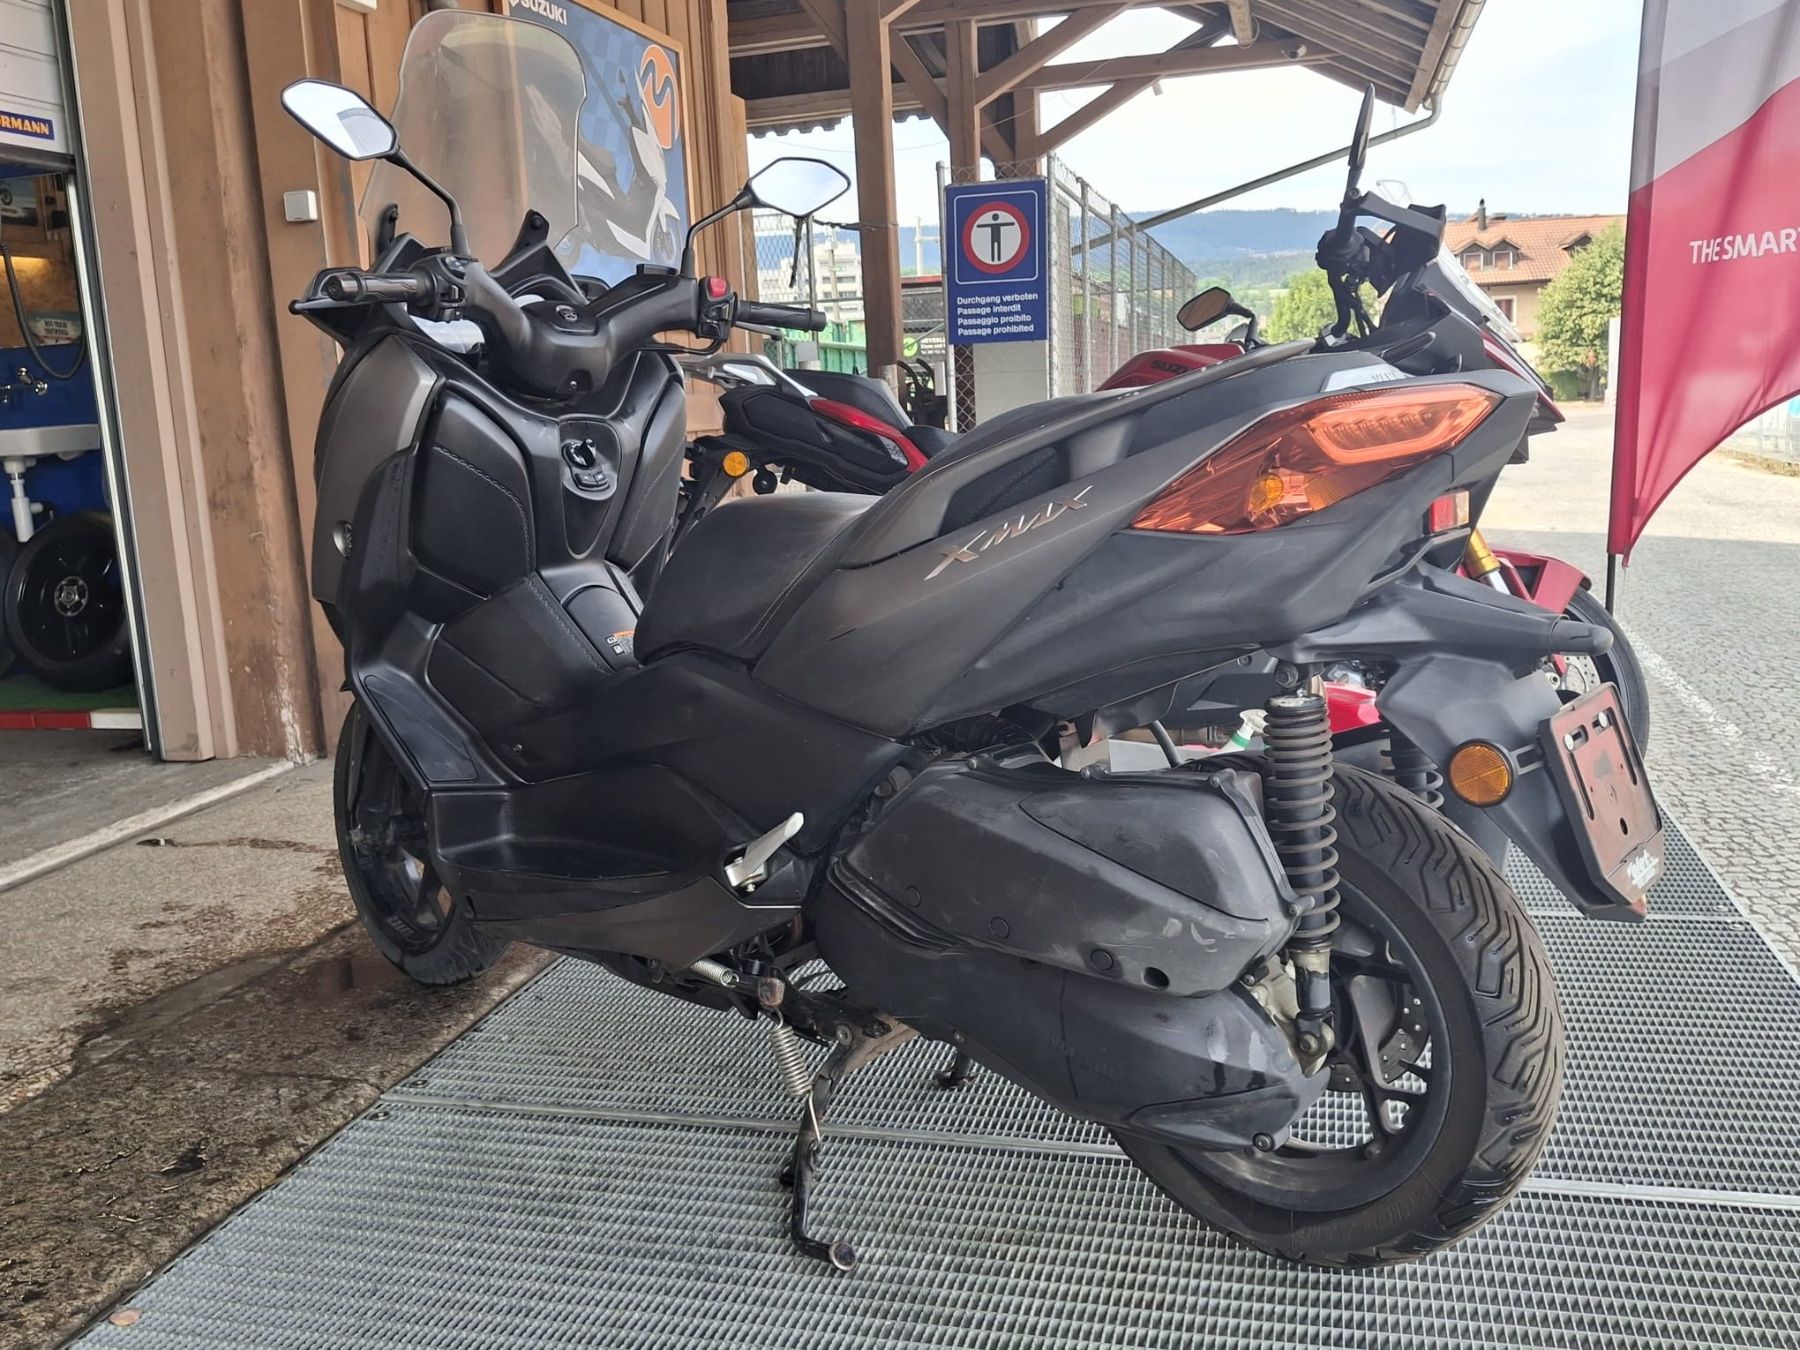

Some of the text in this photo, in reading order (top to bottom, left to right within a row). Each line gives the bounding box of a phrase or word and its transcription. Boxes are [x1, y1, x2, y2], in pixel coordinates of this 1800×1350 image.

[0, 114, 49, 135] RMANN
[1690, 227, 1800, 264] THE SMAR
[957, 292, 1039, 305] Durchgang verboten
[957, 303, 1021, 315] Passage interdit
[957, 314, 1032, 326] Passaggio proibito
[958, 324, 1034, 336] Passage prohibited
